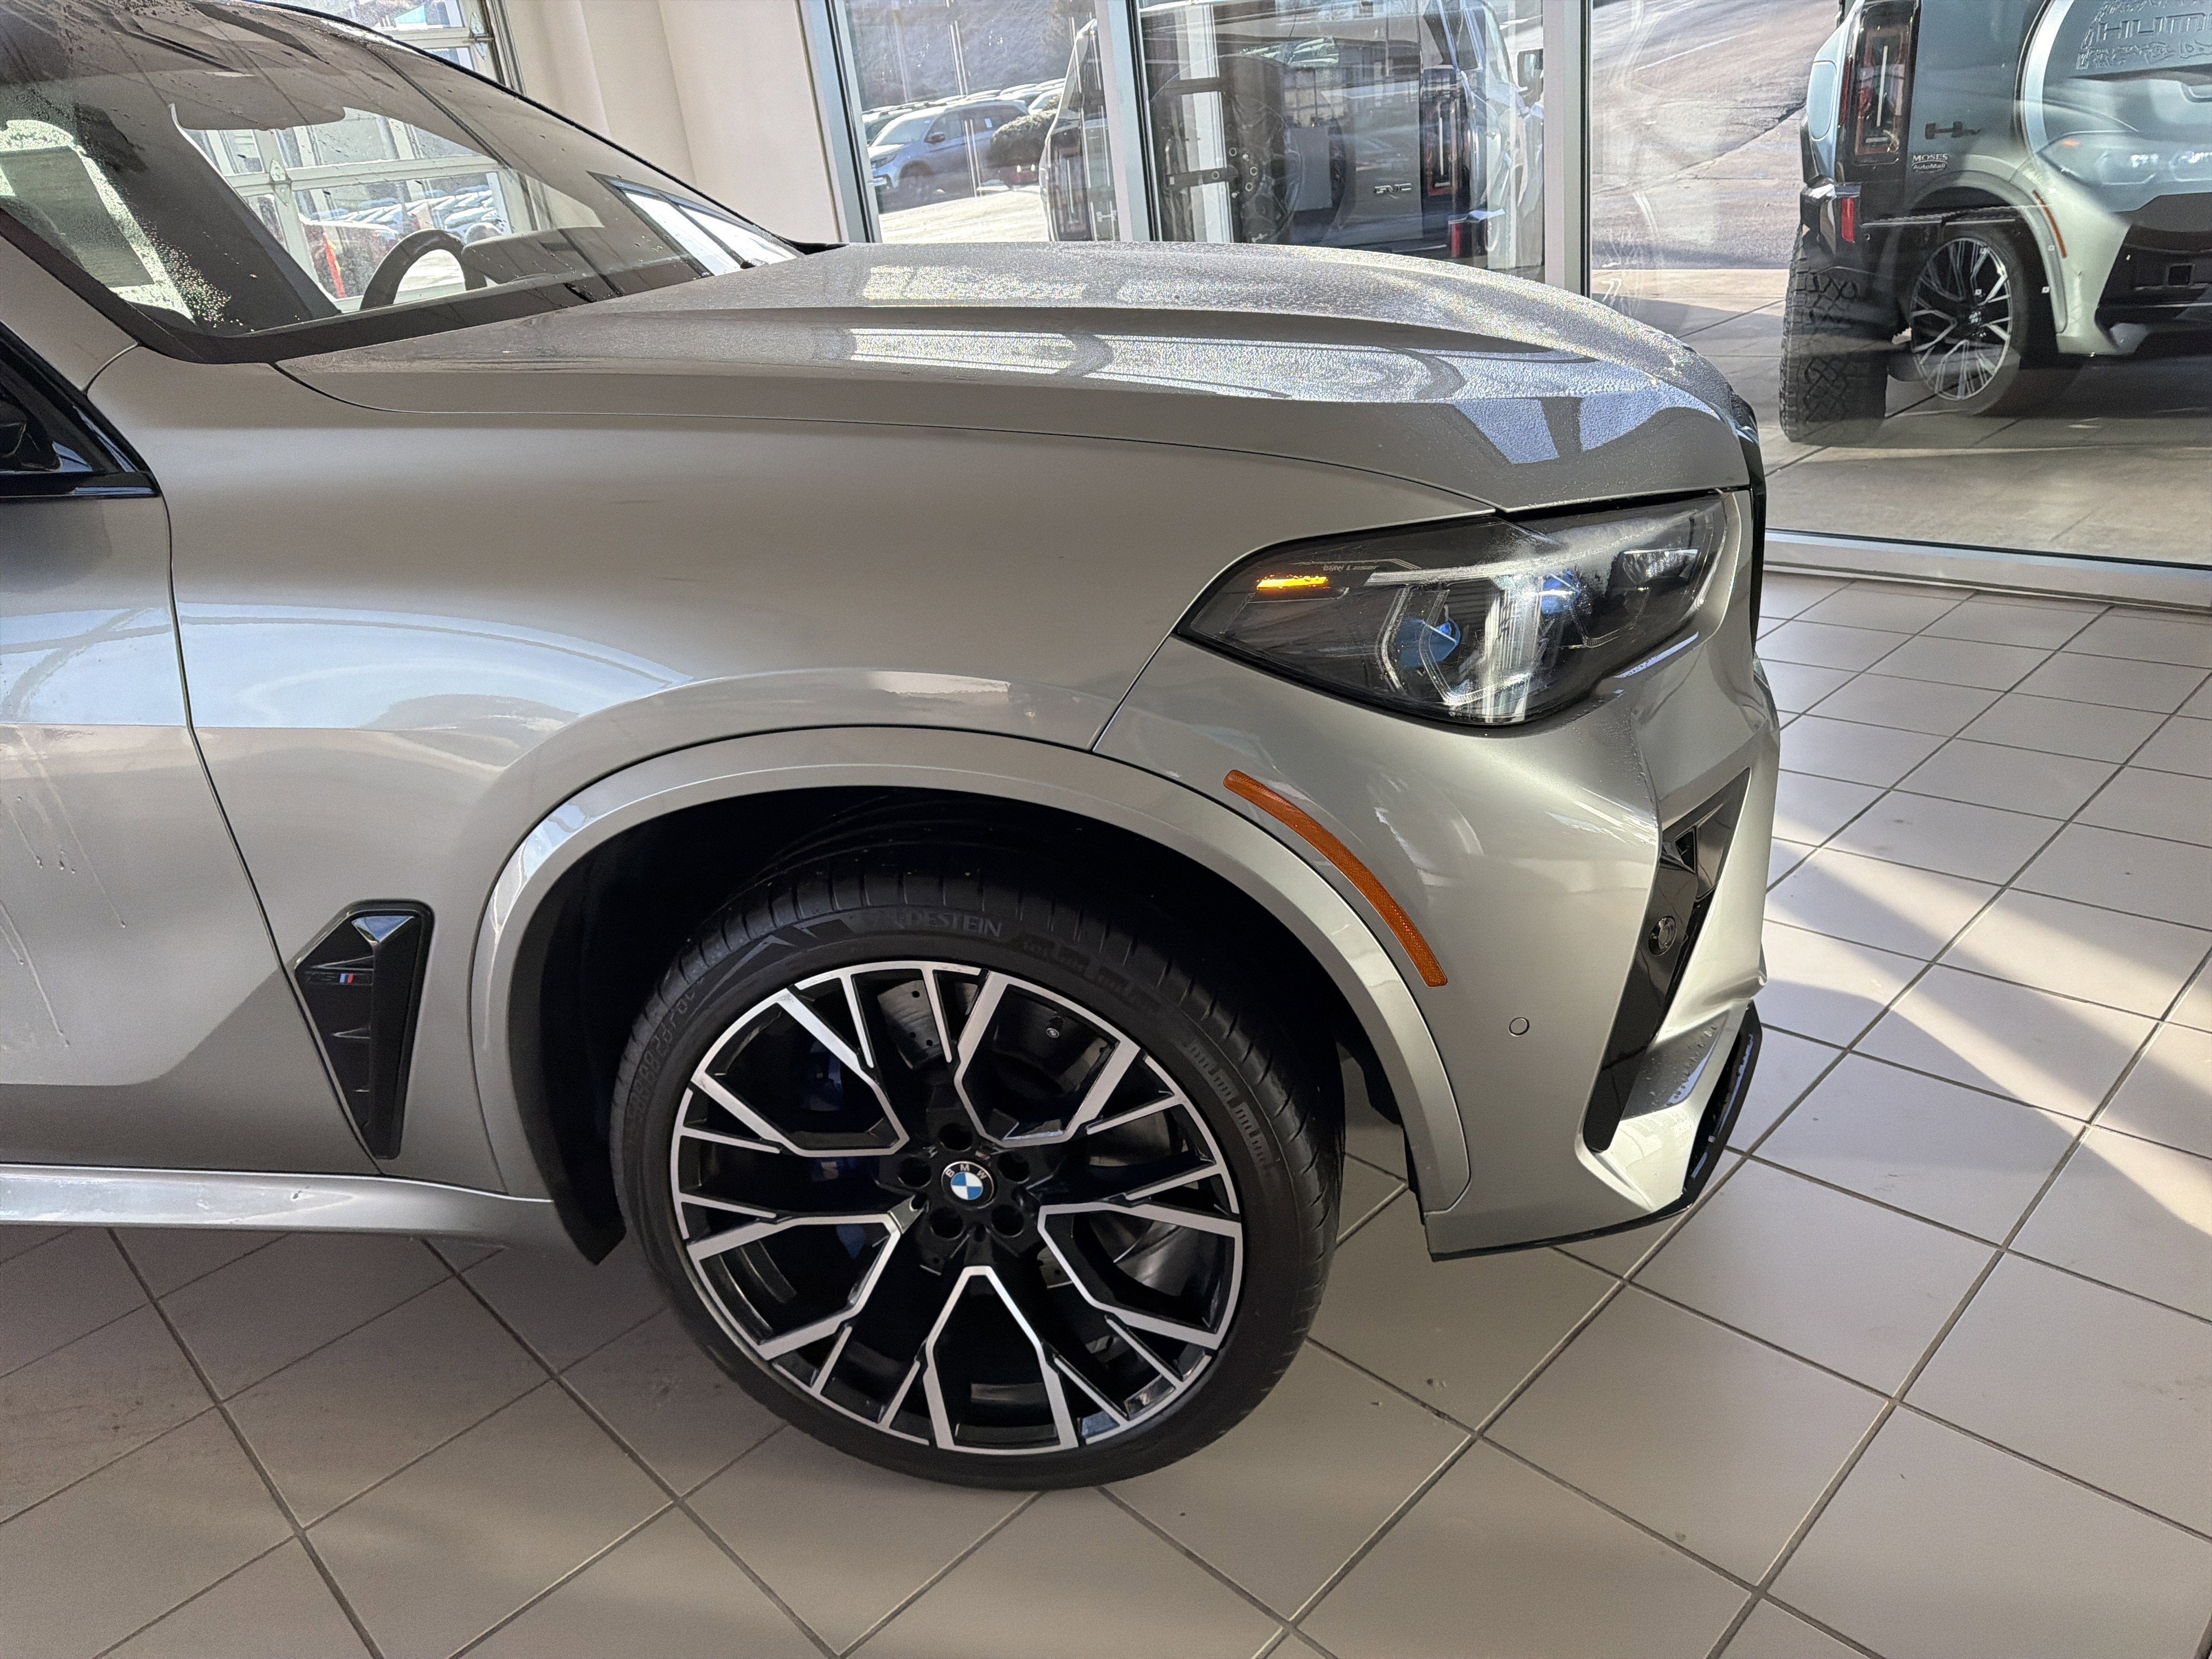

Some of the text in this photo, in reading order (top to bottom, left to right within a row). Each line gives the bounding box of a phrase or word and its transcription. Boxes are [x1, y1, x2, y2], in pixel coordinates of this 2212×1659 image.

[2095, 11, 2212, 43] HUM
[1912, 153, 1948, 163] MOSES
[1374, 183, 1412, 194] GMC
[945, 1163, 988, 1179] BMW
